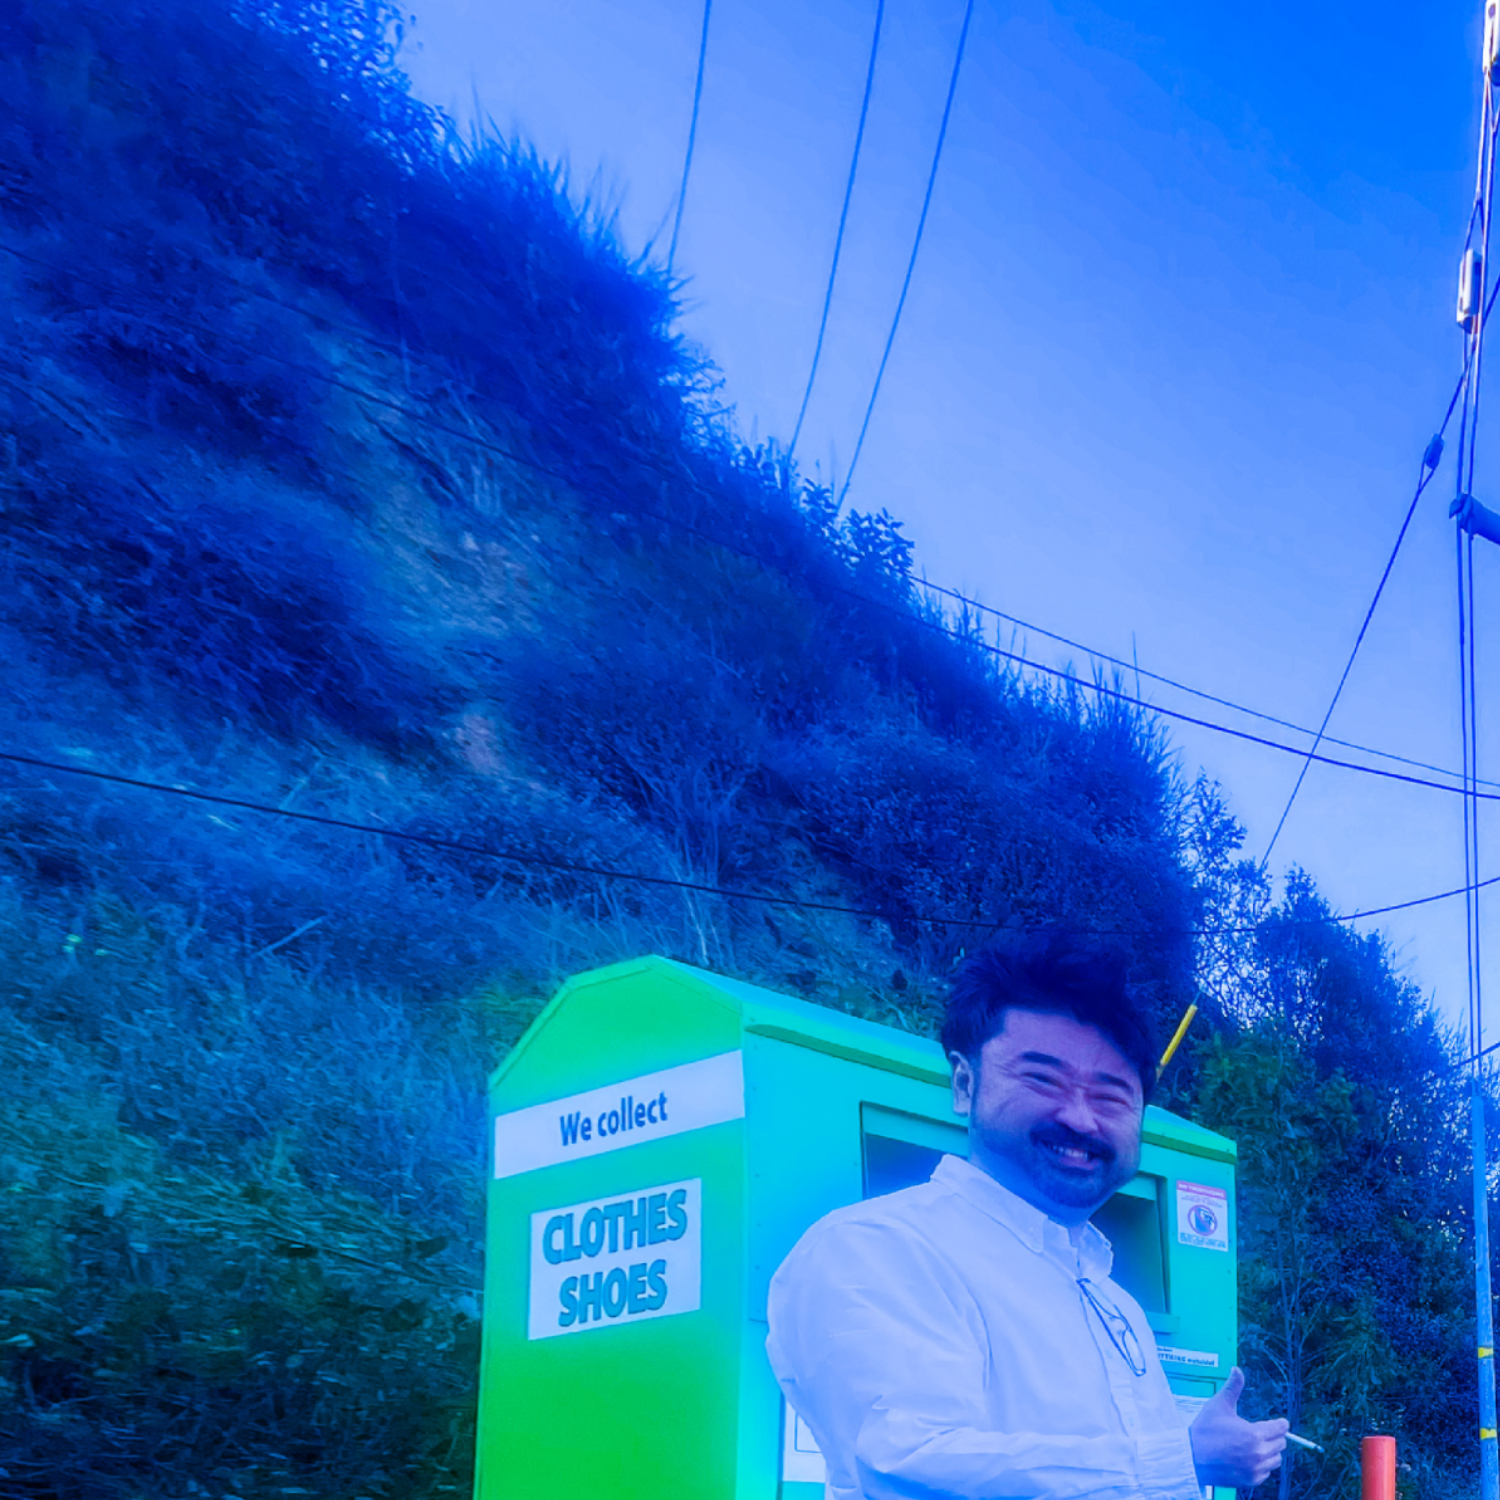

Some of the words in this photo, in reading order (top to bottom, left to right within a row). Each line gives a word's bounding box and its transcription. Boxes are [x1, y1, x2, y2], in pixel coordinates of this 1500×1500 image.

[560, 1111, 592, 1146] We
[597, 1091, 668, 1137] collect
[542, 1188, 688, 1265] CLOTHES
[558, 1258, 668, 1327] SHOES
